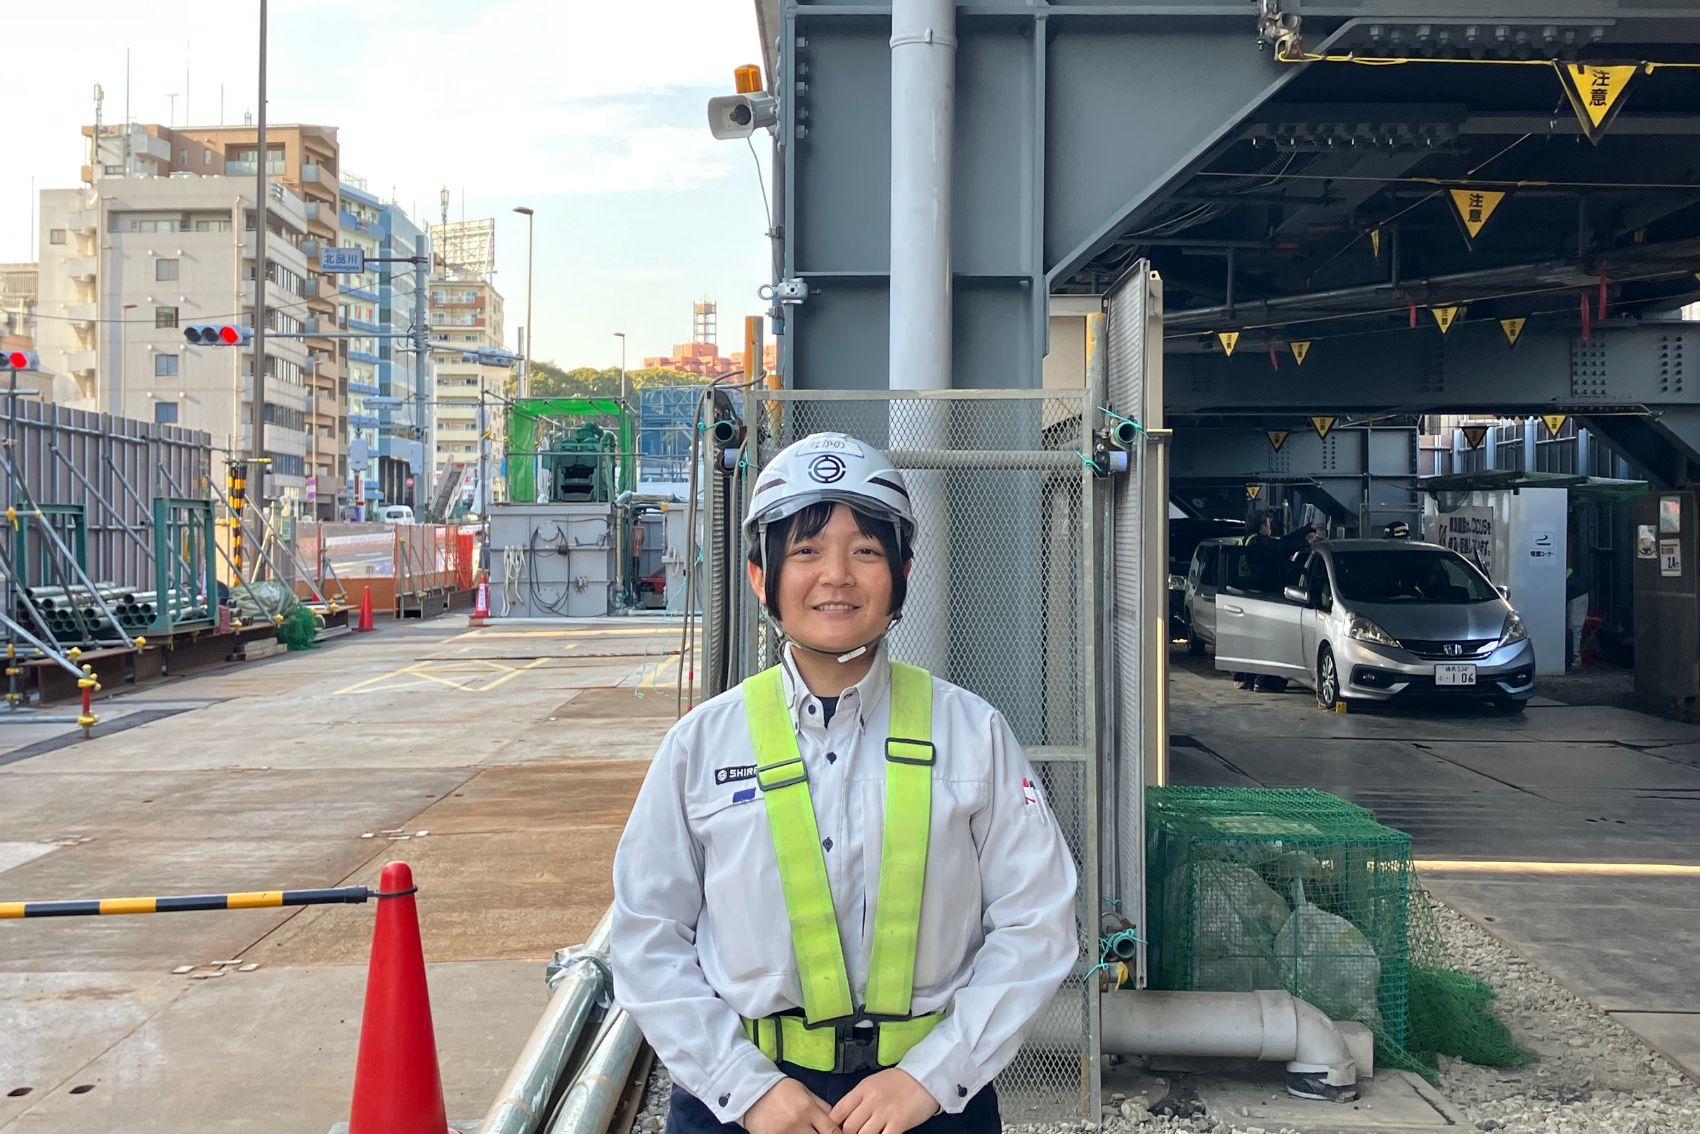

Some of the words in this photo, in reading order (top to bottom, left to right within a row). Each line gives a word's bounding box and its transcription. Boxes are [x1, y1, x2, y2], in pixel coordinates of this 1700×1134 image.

[1588, 69, 1610, 107] 注意
[1467, 192, 1484, 223] 注意
[324, 253, 358, 264] 北品川
